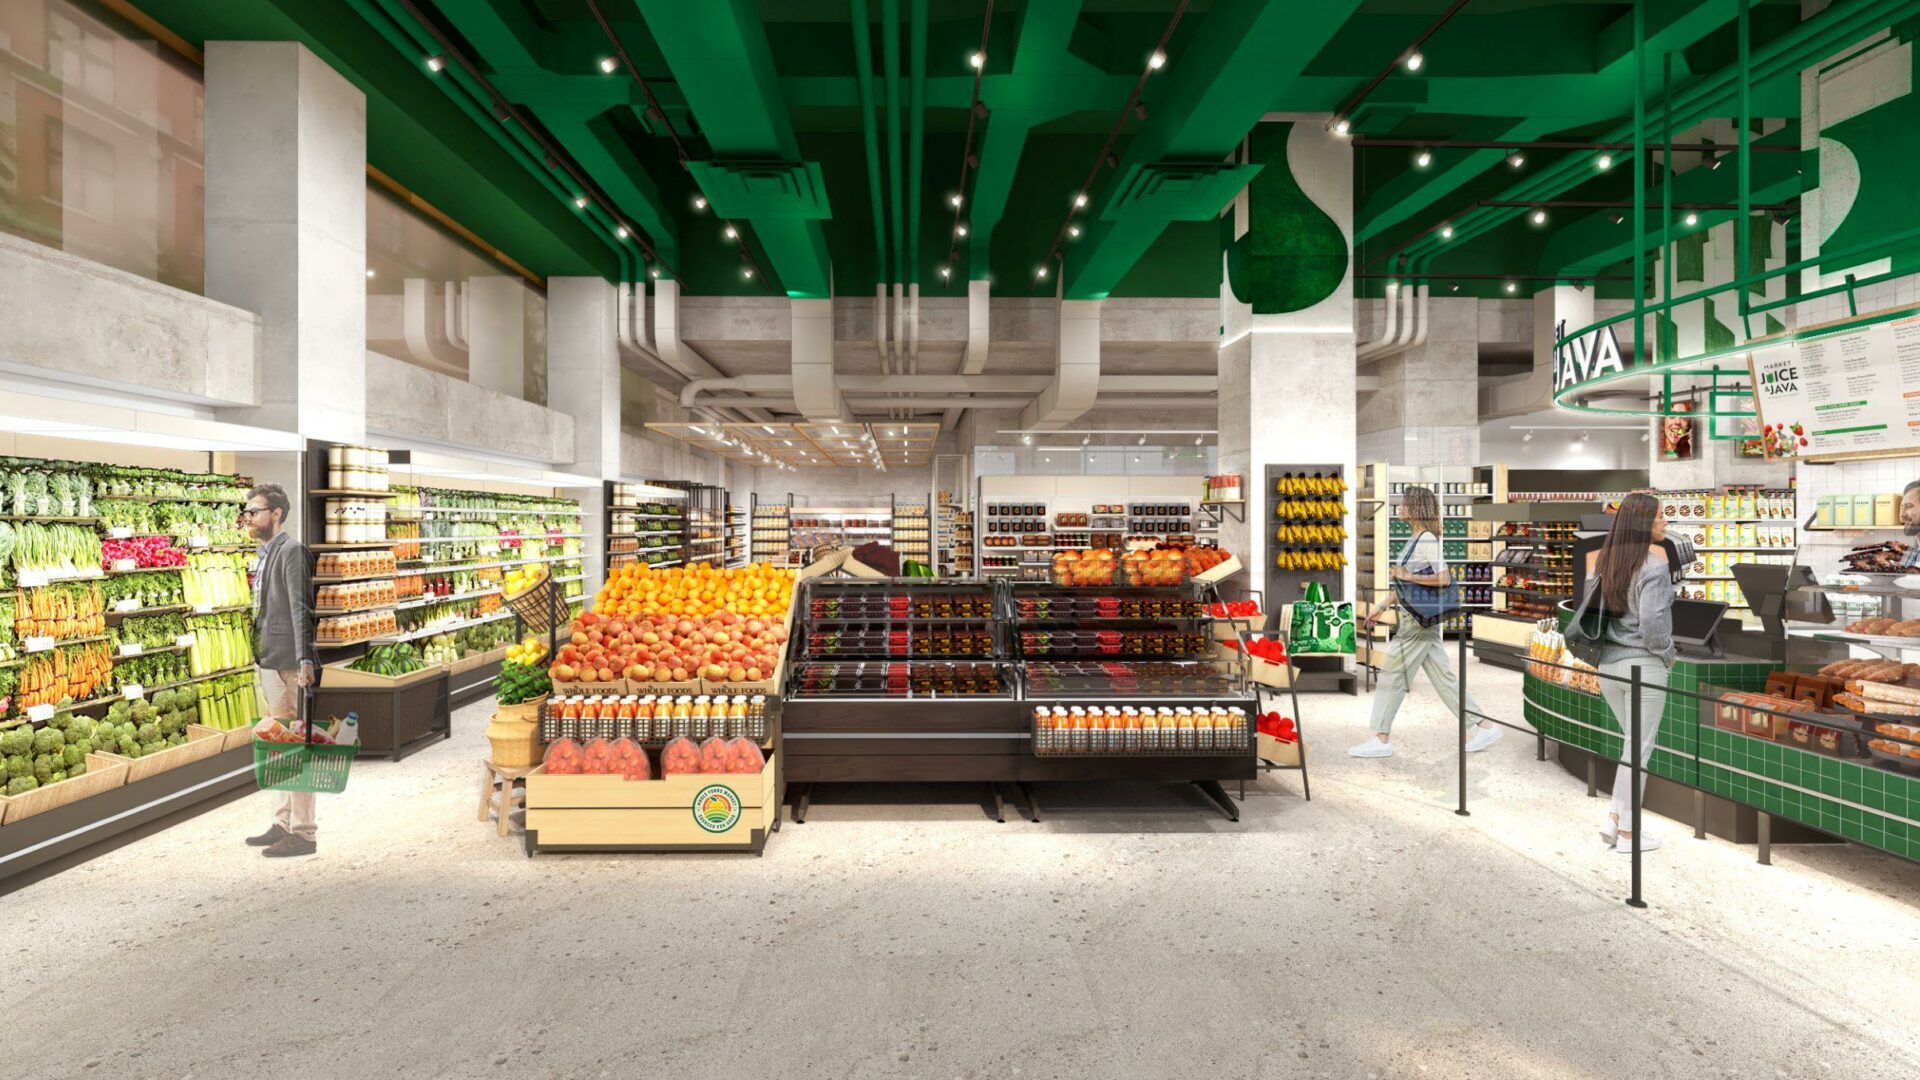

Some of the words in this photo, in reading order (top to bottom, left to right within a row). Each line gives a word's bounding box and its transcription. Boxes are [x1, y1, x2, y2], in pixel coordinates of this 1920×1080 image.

[1554, 325, 1624, 392] JAVA
[1763, 360, 1791, 370] MARKET
[1760, 367, 1798, 385] JUICE
[562, 686, 590, 695] WHOLE
[637, 686, 665, 695] WHOLE
[711, 686, 738, 695] WHOLE
[697, 792, 708, 806] WHOLE
[724, 790, 737, 806] MARKET
